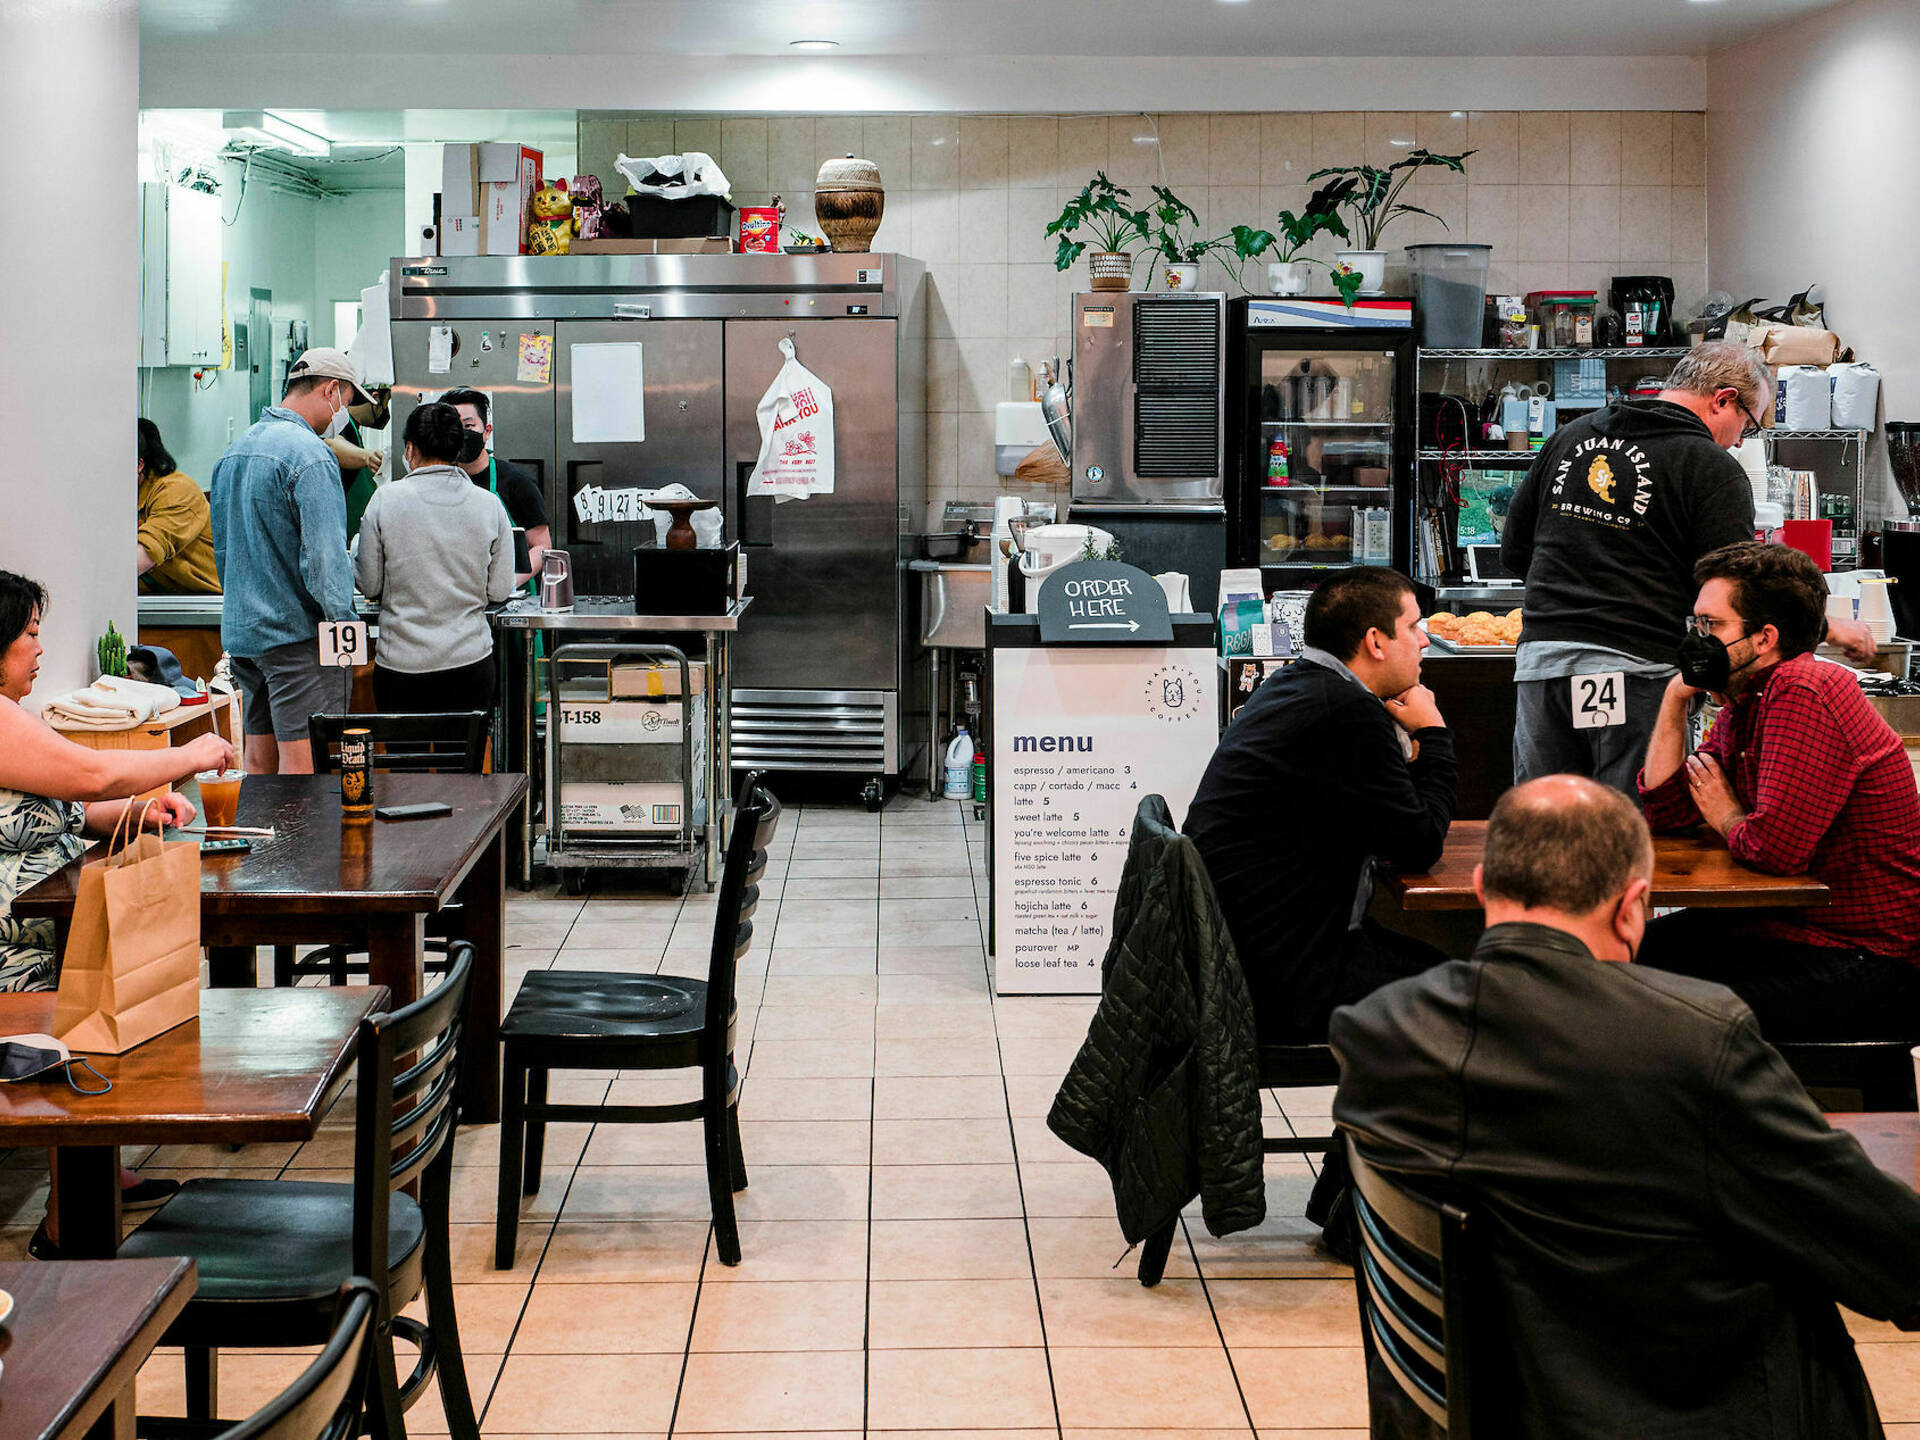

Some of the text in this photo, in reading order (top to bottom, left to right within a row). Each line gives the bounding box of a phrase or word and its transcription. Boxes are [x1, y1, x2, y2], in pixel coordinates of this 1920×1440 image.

[1552, 436, 1653, 515] SAN JUAN ISLAND
[617, 493, 630, 513] 27
[1560, 503, 1613, 521] BREWING
[1460, 526, 1475, 535] 5:18
[1064, 579, 1133, 597] ORDER
[1069, 598, 1127, 617] HERE
[328, 625, 357, 654] 19
[1580, 677, 1617, 713] 24
[560, 710, 601, 724] T-158
[341, 741, 365, 753] Liquid
[1013, 736, 1093, 752] menu
[342, 753, 365, 765] Death
[1013, 766, 1055, 776] espresso
[1066, 765, 1115, 775] americano
[1124, 765, 1131, 774] 3
[1013, 782, 1037, 792] capp
[1048, 781, 1084, 790] cortado
[1096, 782, 1121, 790] macc
[1130, 781, 1137, 790] 4
[1014, 796, 1050, 806] latte 5
[1014, 812, 1080, 821] sweet latte 5
[1014, 827, 1126, 839] you're welcome latte 6
[1014, 851, 1098, 864] five spice latte 6
[1014, 877, 1098, 888] espresso tonic 6
[1014, 901, 1088, 912] hojicha latte 6
[1014, 925, 1048, 935] matcha
[1051, 925, 1069, 936] (tea
[1081, 925, 1104, 936] latte)
[1015, 944, 1058, 954] pourover
[1015, 957, 1095, 968] loose leaf tea 4
